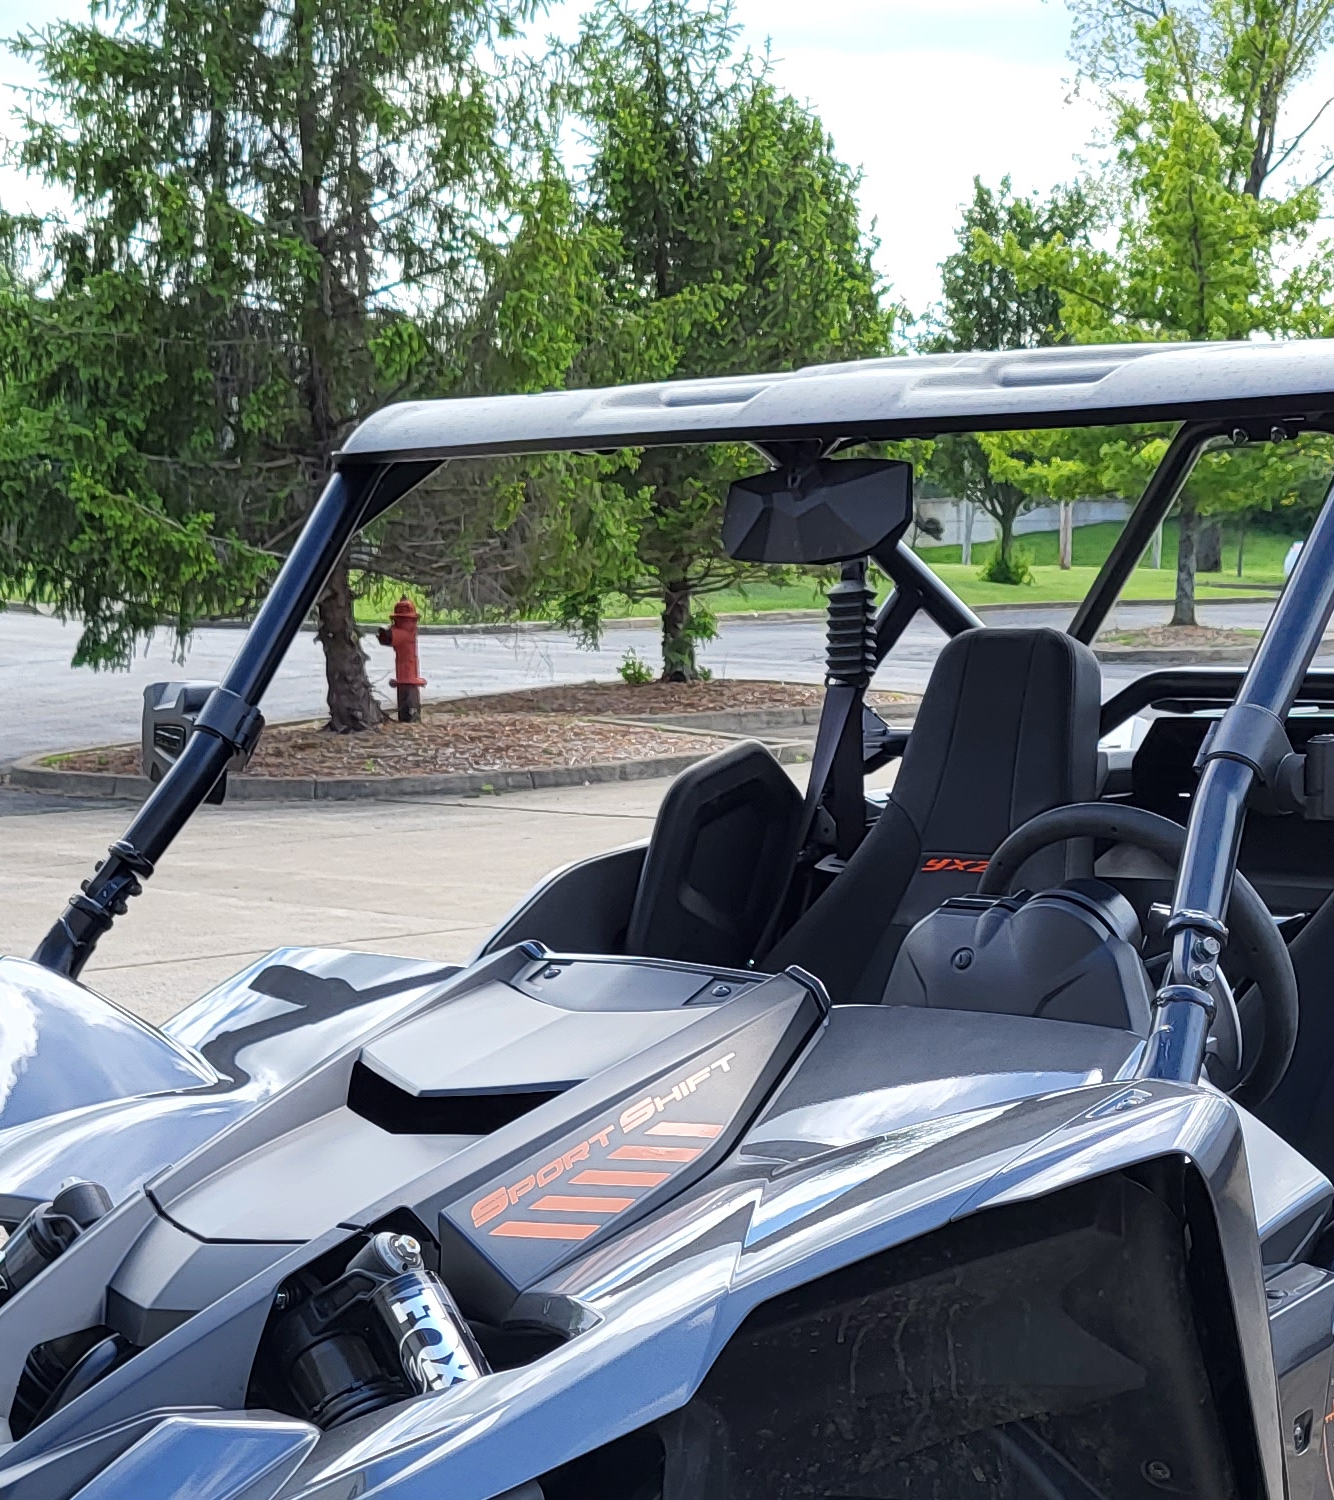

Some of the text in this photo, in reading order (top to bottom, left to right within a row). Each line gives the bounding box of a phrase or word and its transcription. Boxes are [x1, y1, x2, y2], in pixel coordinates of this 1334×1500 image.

[470, 1051, 737, 1228] SPORT SHIFT
[387, 1287, 480, 1392] FOX
